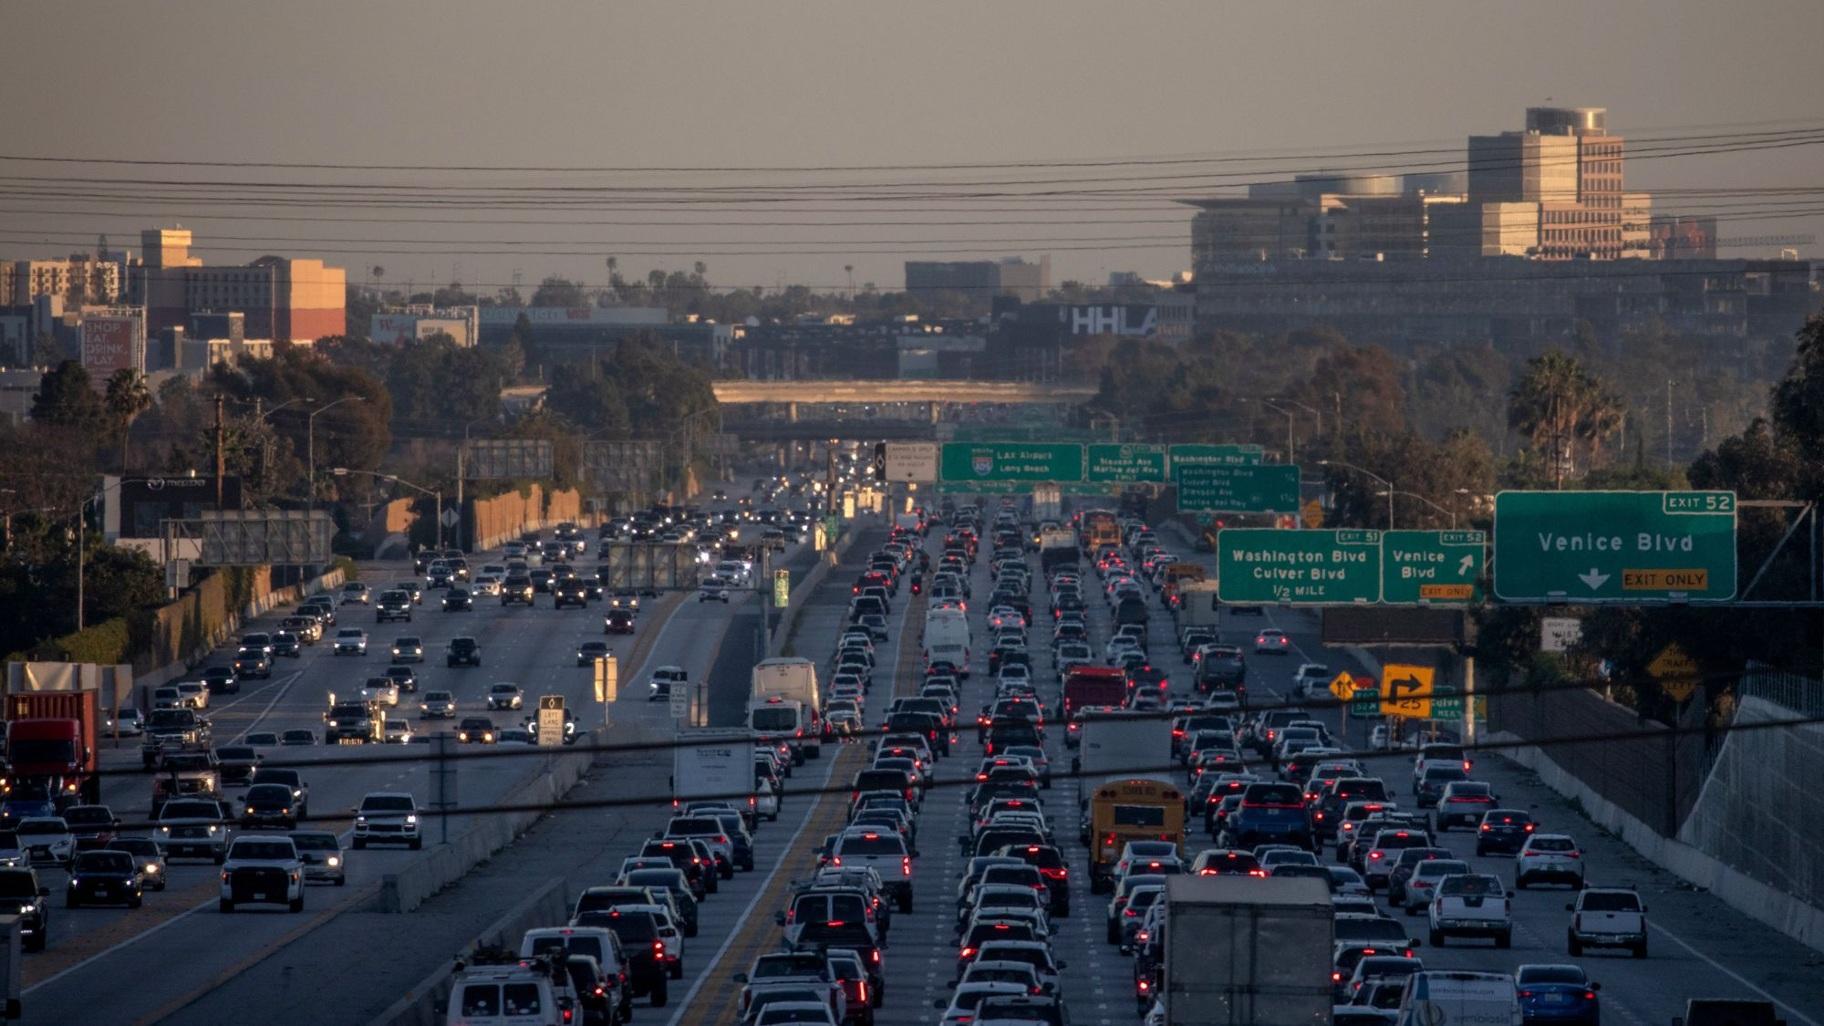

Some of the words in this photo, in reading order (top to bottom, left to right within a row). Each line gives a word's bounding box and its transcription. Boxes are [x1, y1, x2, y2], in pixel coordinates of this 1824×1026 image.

[1072, 306, 1157, 334] HHLA
[1669, 498, 1700, 507] EXIT
[1706, 496, 1731, 510] 52
[1366, 532, 1378, 542] 51
[1467, 534, 1482, 542] 52
[1538, 532, 1623, 551] Venice
[1637, 533, 1694, 551] Blvd
[1232, 550, 1324, 564] Washington
[1332, 550, 1367, 562] Blvd
[1393, 550, 1445, 562] Venice
[1253, 567, 1304, 579] Culver
[1311, 567, 1346, 579] Blvd
[1401, 566, 1435, 578] Blvd
[1624, 574, 1658, 585] EXIT
[1665, 574, 1706, 585] ONLY
[1273, 585, 1291, 597] 1/2
[1295, 586, 1325, 595] MILE
[1422, 586, 1444, 595] EXIT
[1446, 586, 1473, 595] ONLY
[1401, 699, 1421, 710] 25
